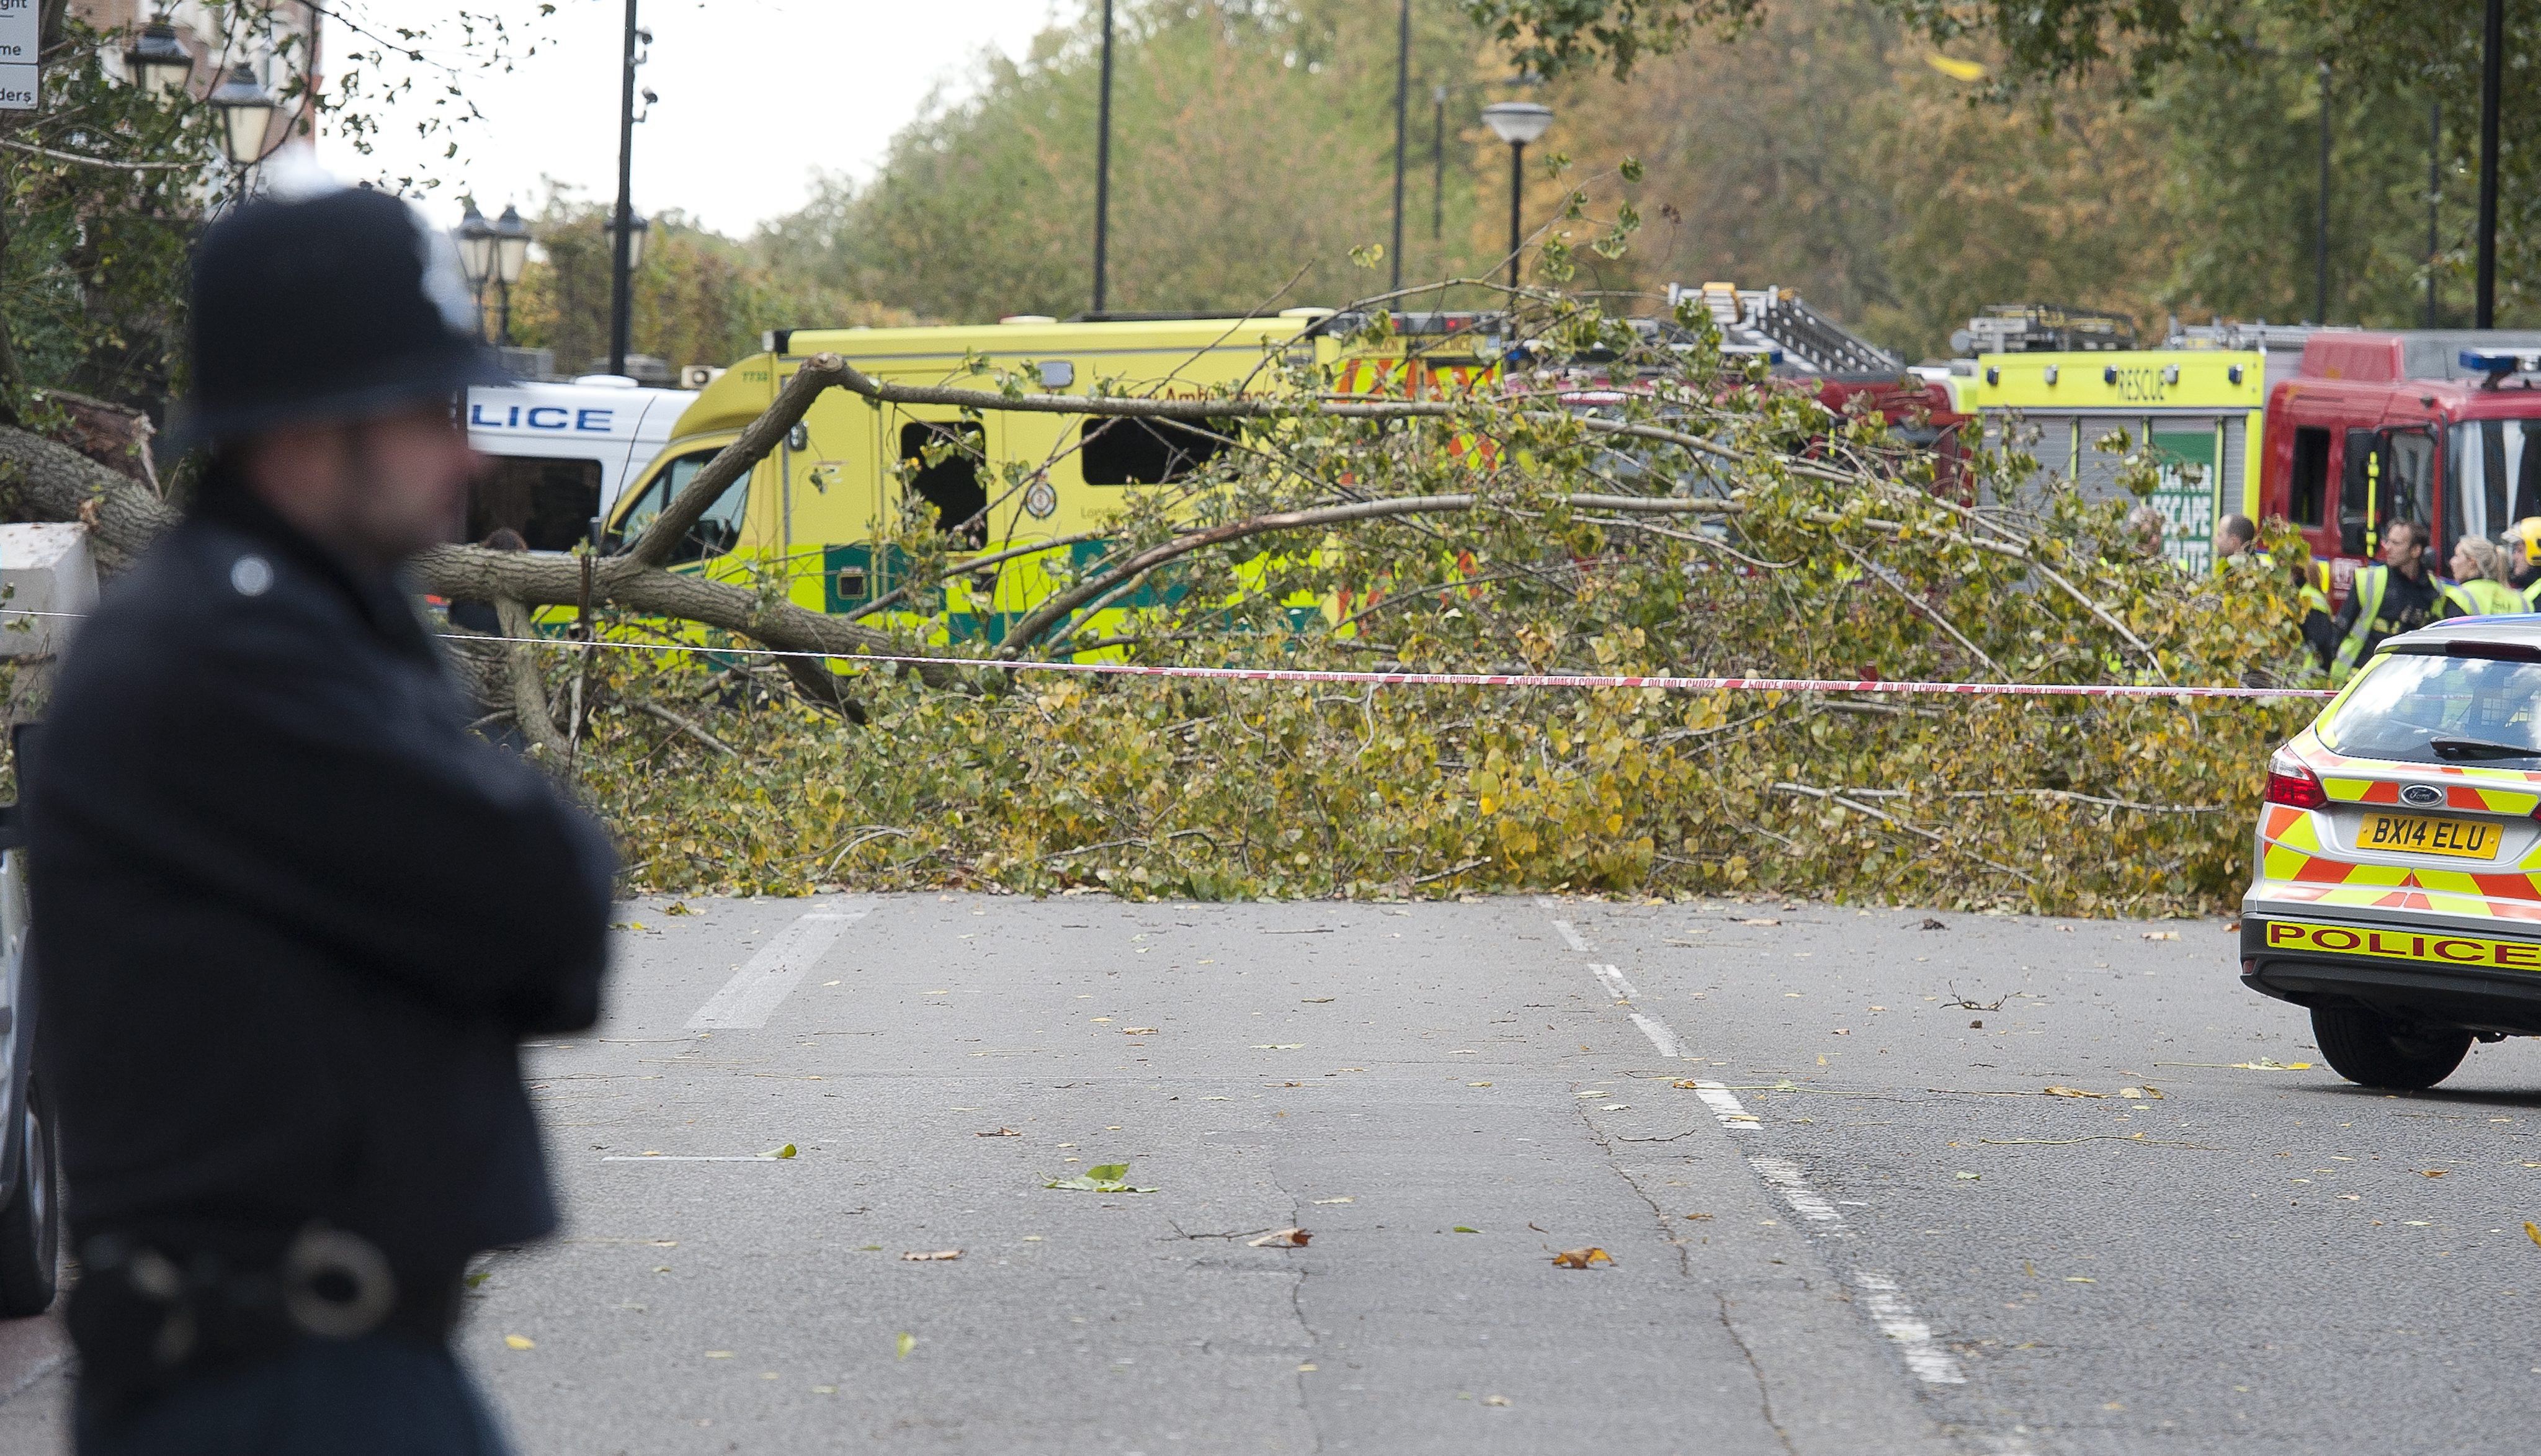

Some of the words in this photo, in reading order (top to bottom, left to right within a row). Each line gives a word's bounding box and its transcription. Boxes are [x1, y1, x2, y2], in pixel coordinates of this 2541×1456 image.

[2118, 368, 2164, 401] RESCUE
[2152, 494, 2212, 537] ESCAPE
[2409, 787, 2432, 801] Ford
[2372, 818, 2428, 846] BX14
[2432, 821, 2486, 851] ELU
[2271, 924, 2541, 967] POLICE
